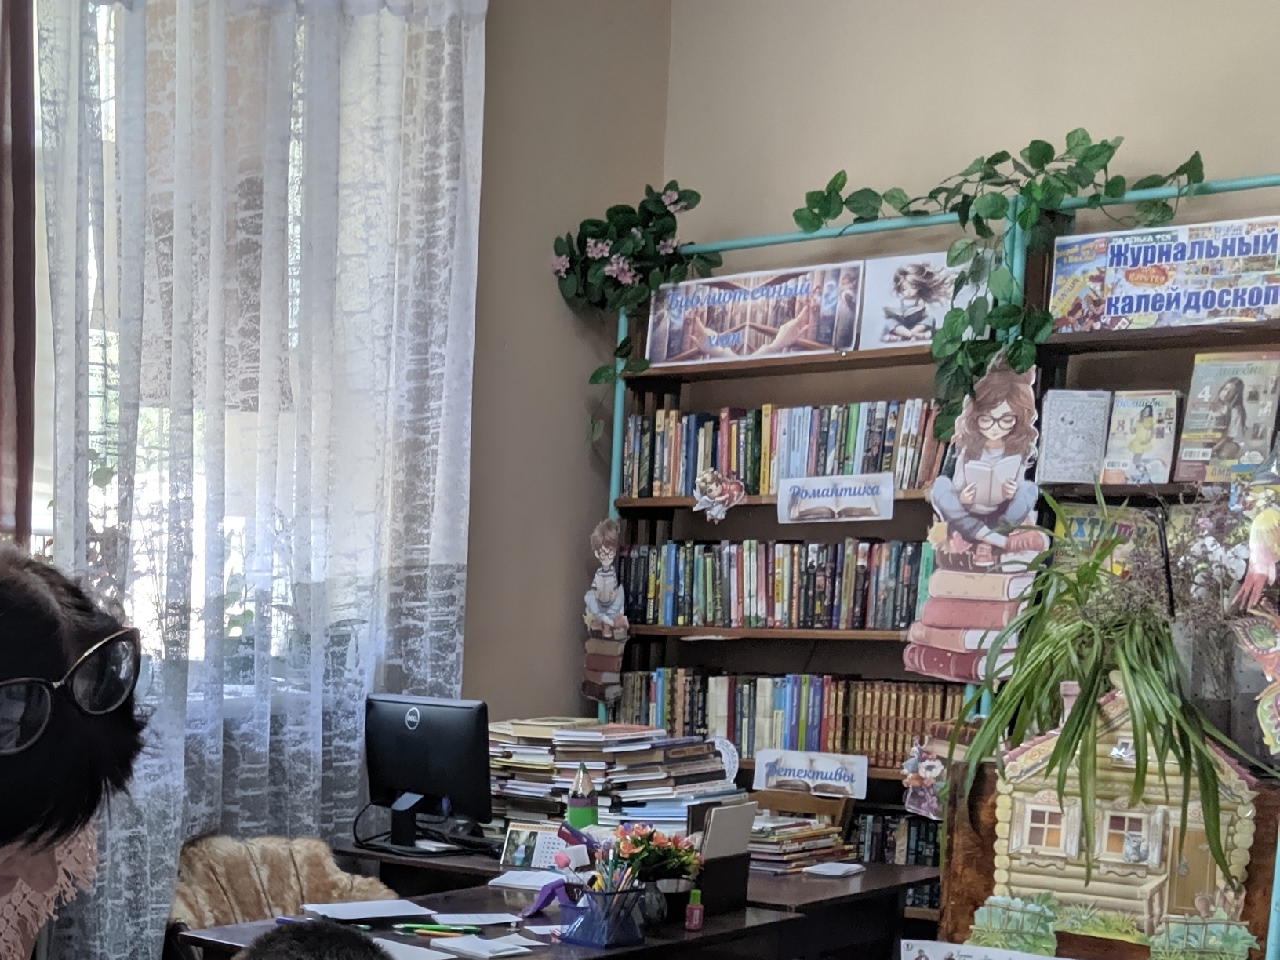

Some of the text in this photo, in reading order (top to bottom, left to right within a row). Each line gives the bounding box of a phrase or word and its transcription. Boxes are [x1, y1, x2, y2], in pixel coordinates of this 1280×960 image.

[1108, 228, 1279, 268] Журнальный
[667, 279, 811, 310] Библиотечный
[1106, 284, 1280, 316] калейдоскоп
[789, 483, 881, 501] Романтика
[765, 760, 856, 783] Детективы
